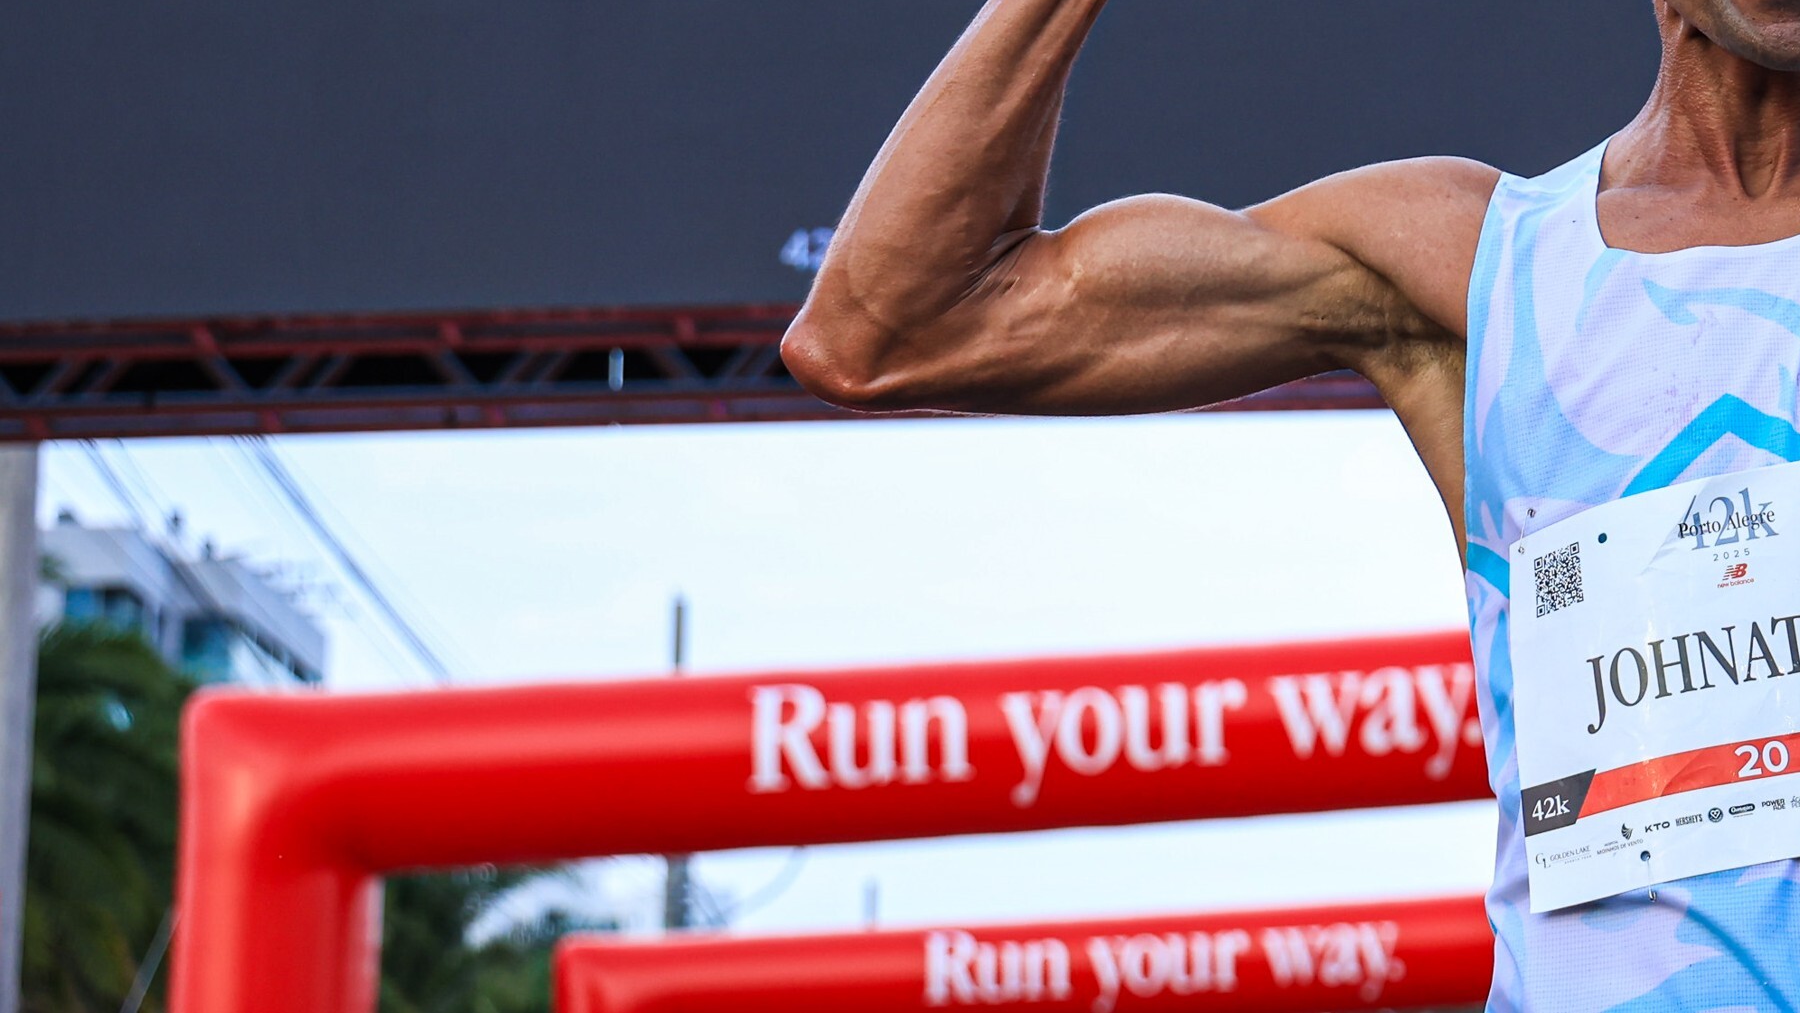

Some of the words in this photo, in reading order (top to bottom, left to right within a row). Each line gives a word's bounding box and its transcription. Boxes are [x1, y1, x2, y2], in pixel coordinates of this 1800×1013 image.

[1678, 487, 1780, 550] 42k
[1678, 520, 1721, 539] Porto
[1727, 510, 1776, 530] Alegre
[1713, 548, 1750, 562] 2025
[748, 683, 977, 793] Run
[1001, 678, 1248, 808] your
[1265, 662, 1485, 781] way.
[1734, 740, 1789, 779] 20
[1532, 794, 1571, 821] 42k
[1761, 799, 1786, 807] POWER
[1645, 821, 1670, 833] KTO
[1675, 814, 1703, 826] HERSHEY'S
[924, 928, 1071, 1007] Run
[1087, 928, 1252, 1013] your
[1261, 921, 1406, 1003] way.
